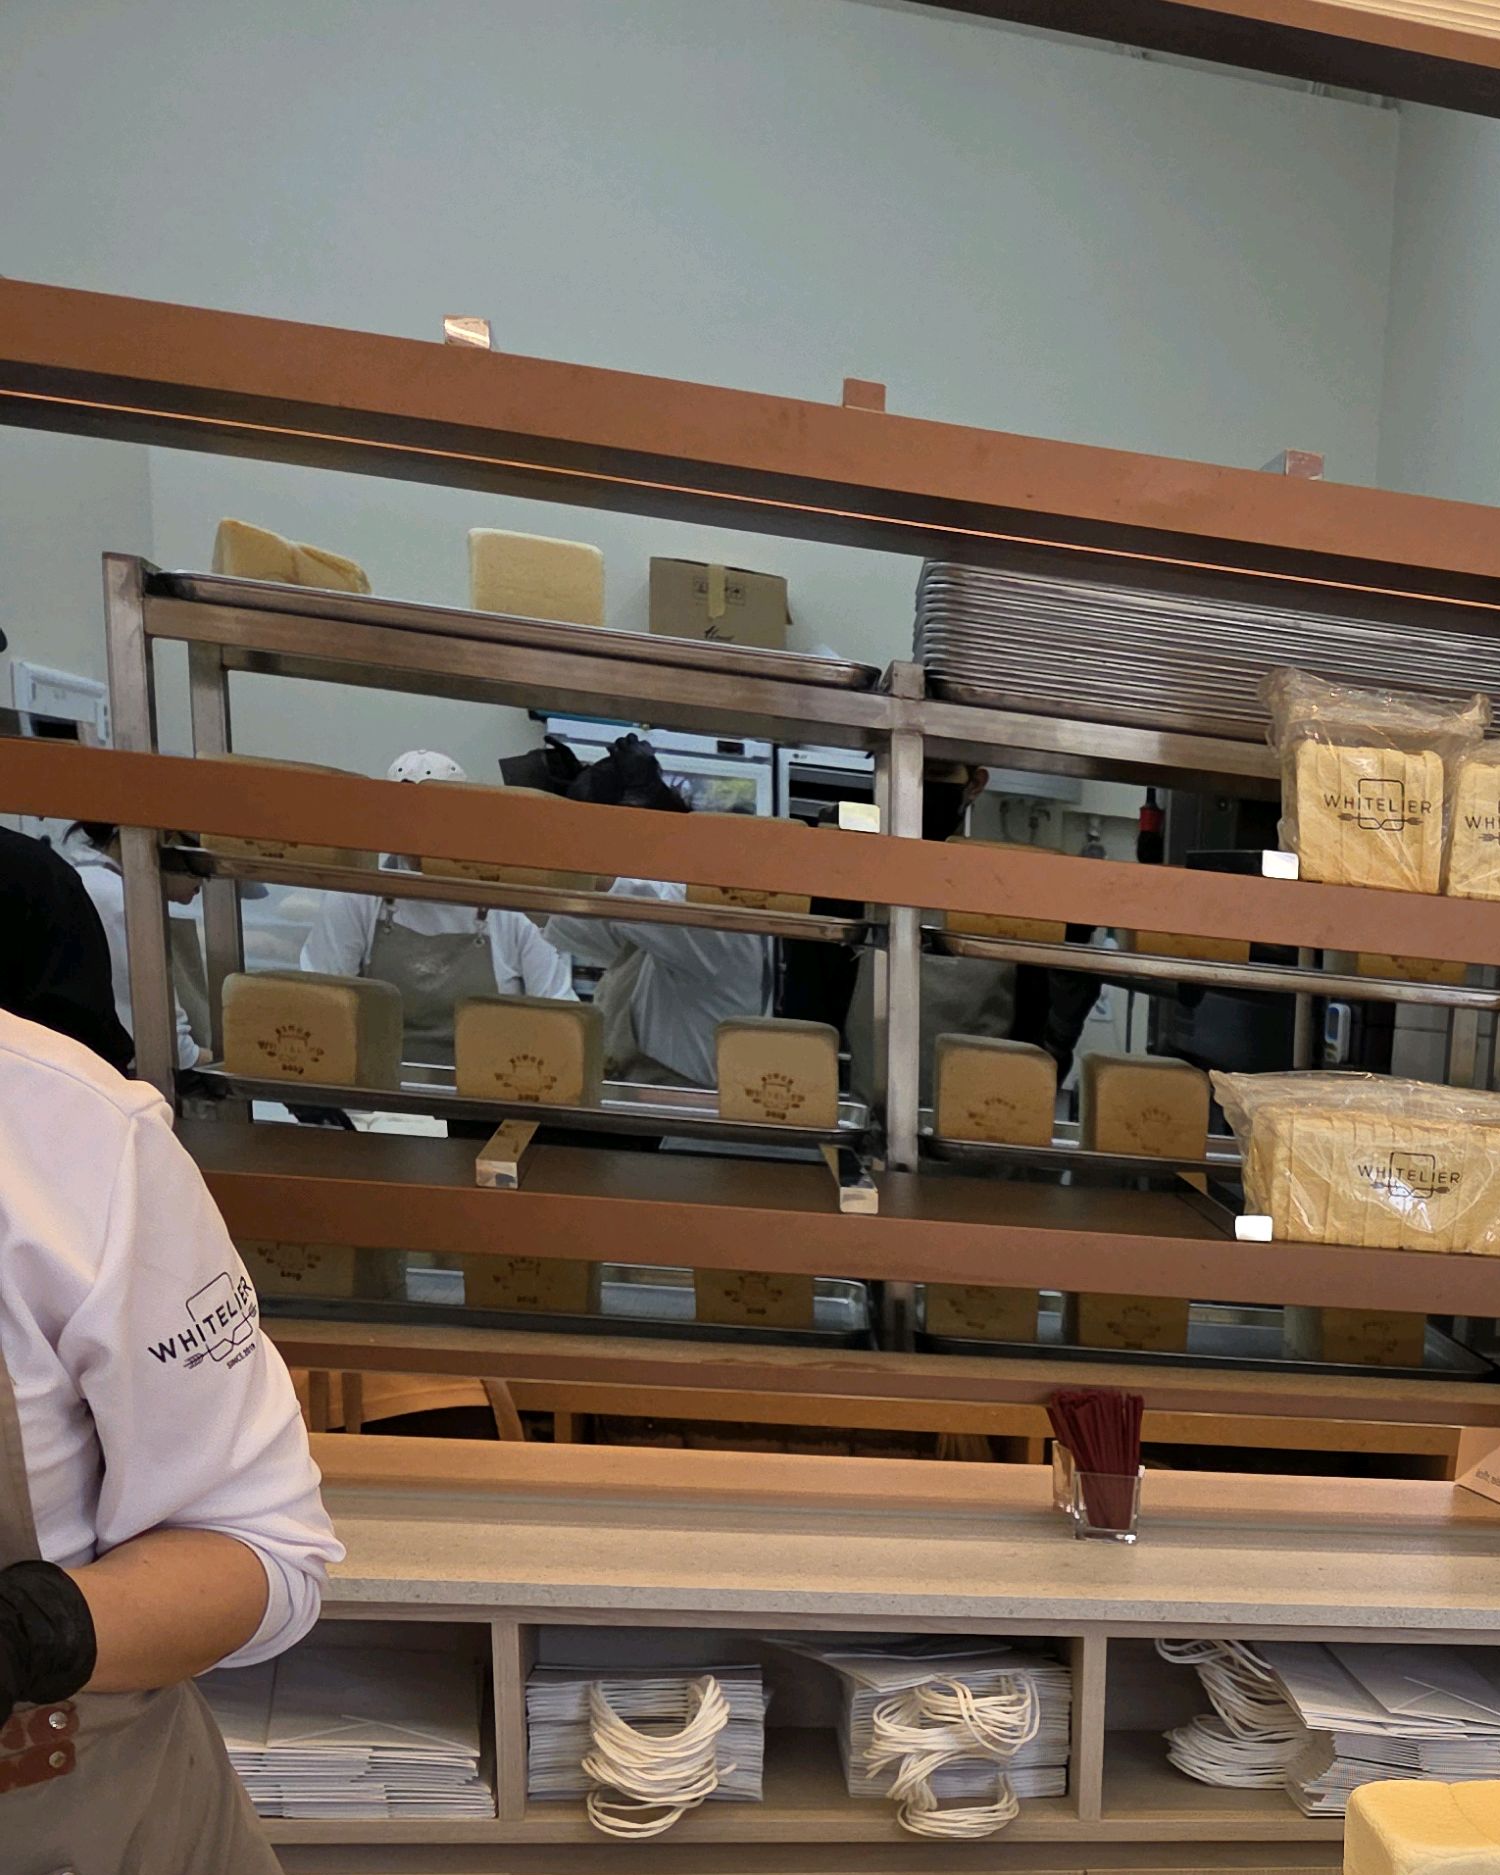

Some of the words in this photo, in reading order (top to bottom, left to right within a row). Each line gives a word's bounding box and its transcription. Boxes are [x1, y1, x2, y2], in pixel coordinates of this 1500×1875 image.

[1323, 793, 1431, 814] WHITELIER
[1357, 1165, 1461, 1184] WHITELIER
[148, 1276, 252, 1363] WHITELIER
